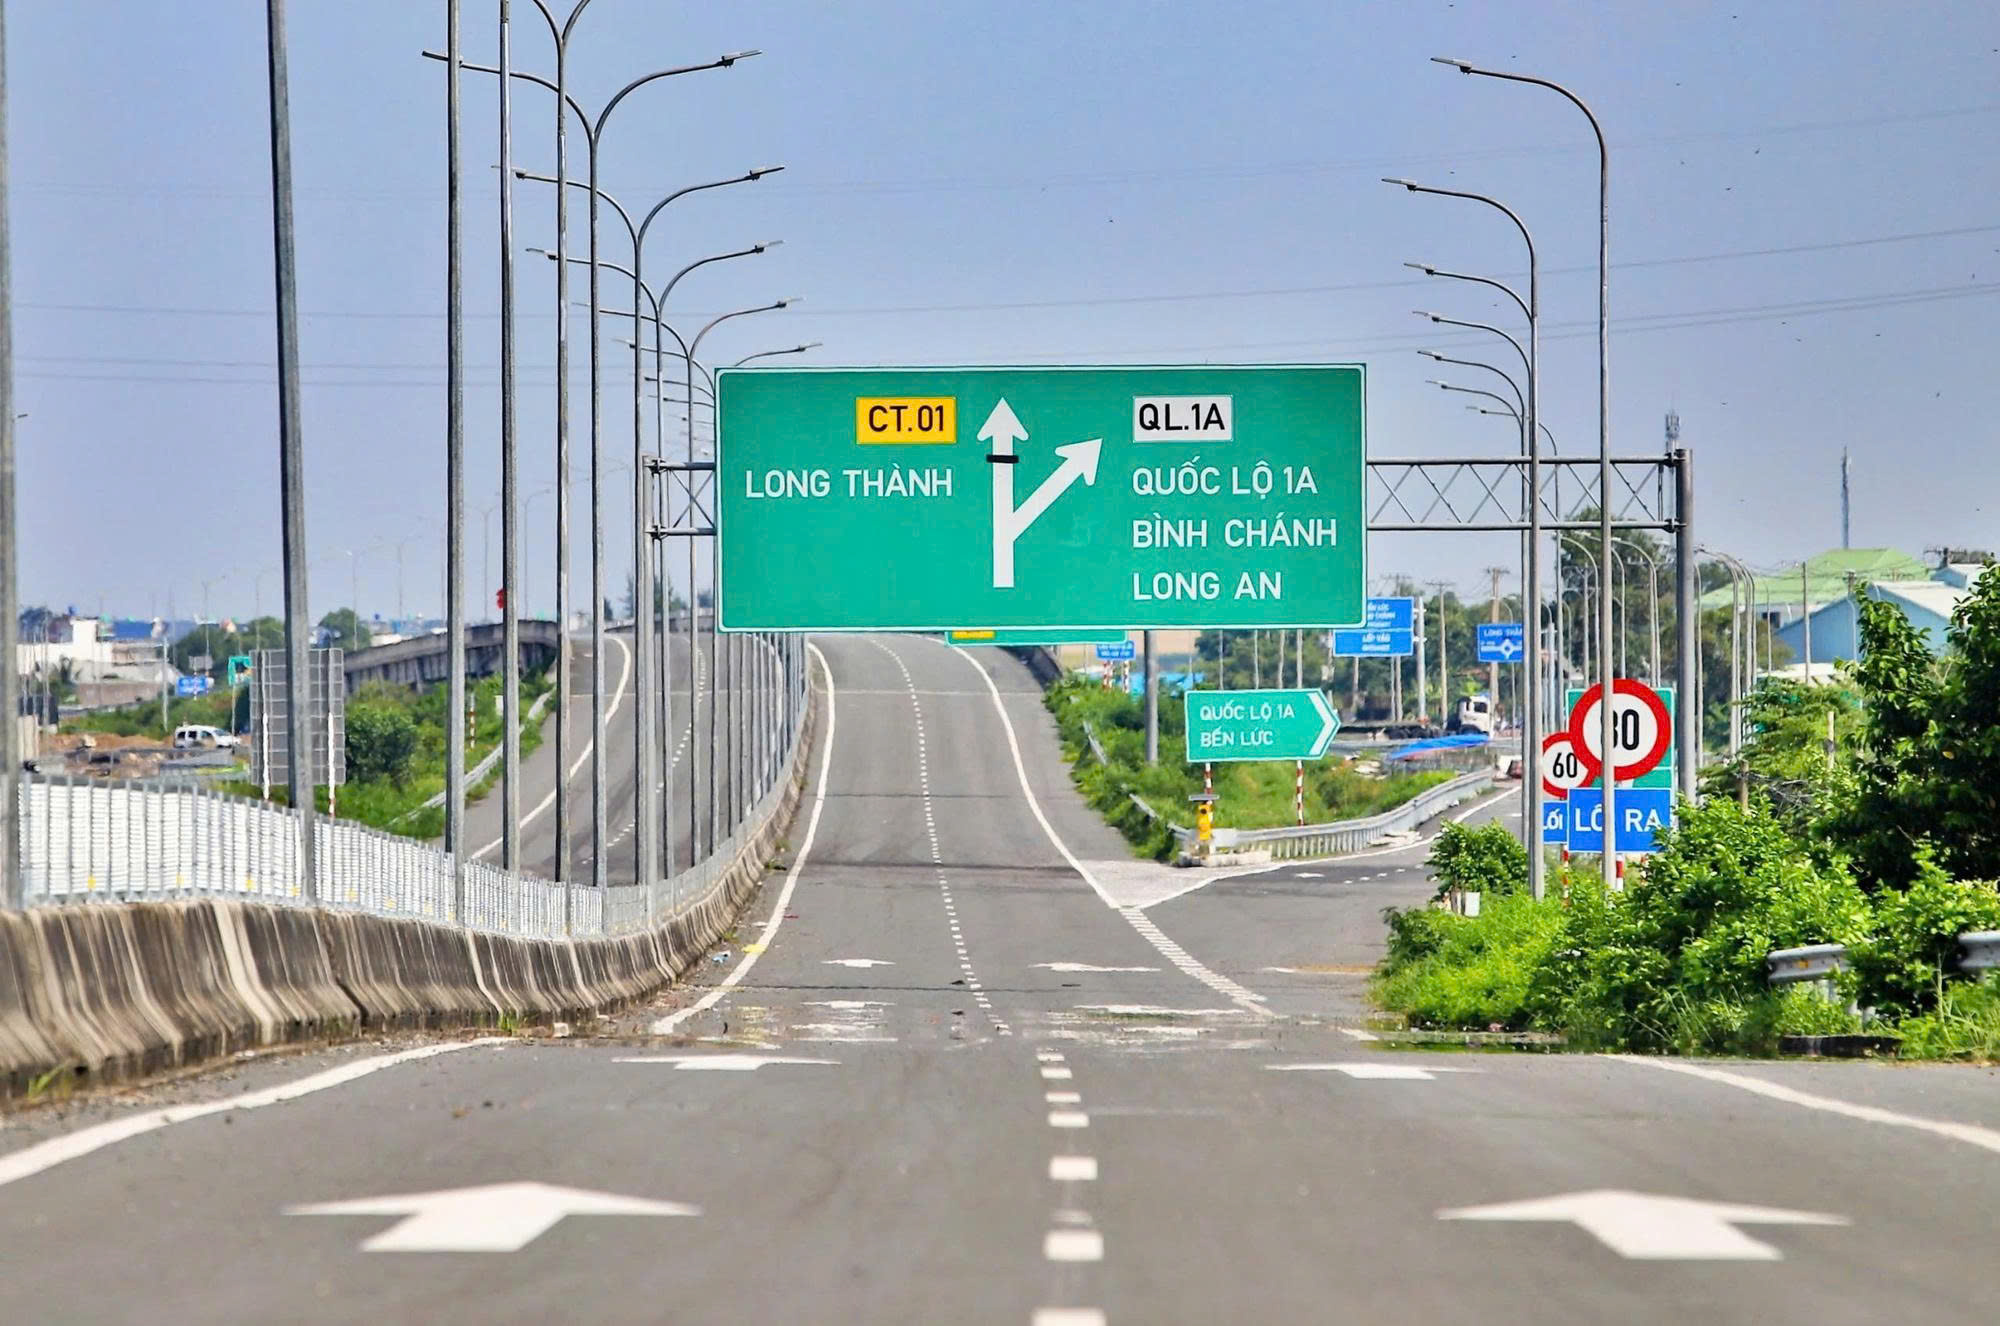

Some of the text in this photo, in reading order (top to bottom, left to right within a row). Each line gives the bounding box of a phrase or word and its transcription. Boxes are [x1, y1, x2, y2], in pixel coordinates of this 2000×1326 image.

[868, 404, 944, 433] CT.01
[1139, 403, 1226, 431] QL.1A
[746, 464, 952, 498] LONG THÀNH
[1132, 457, 1318, 499] QUỐC LỘ 1A
[1132, 513, 1337, 548] BÌNH CHÁNH
[1133, 571, 1281, 600] LONG AN
[1199, 699, 1295, 722] QUỐC LỘ 1A
[1200, 726, 1274, 748] BẾN LỨC
[1552, 752, 1578, 779] 60
[1625, 808, 1662, 833] RA
